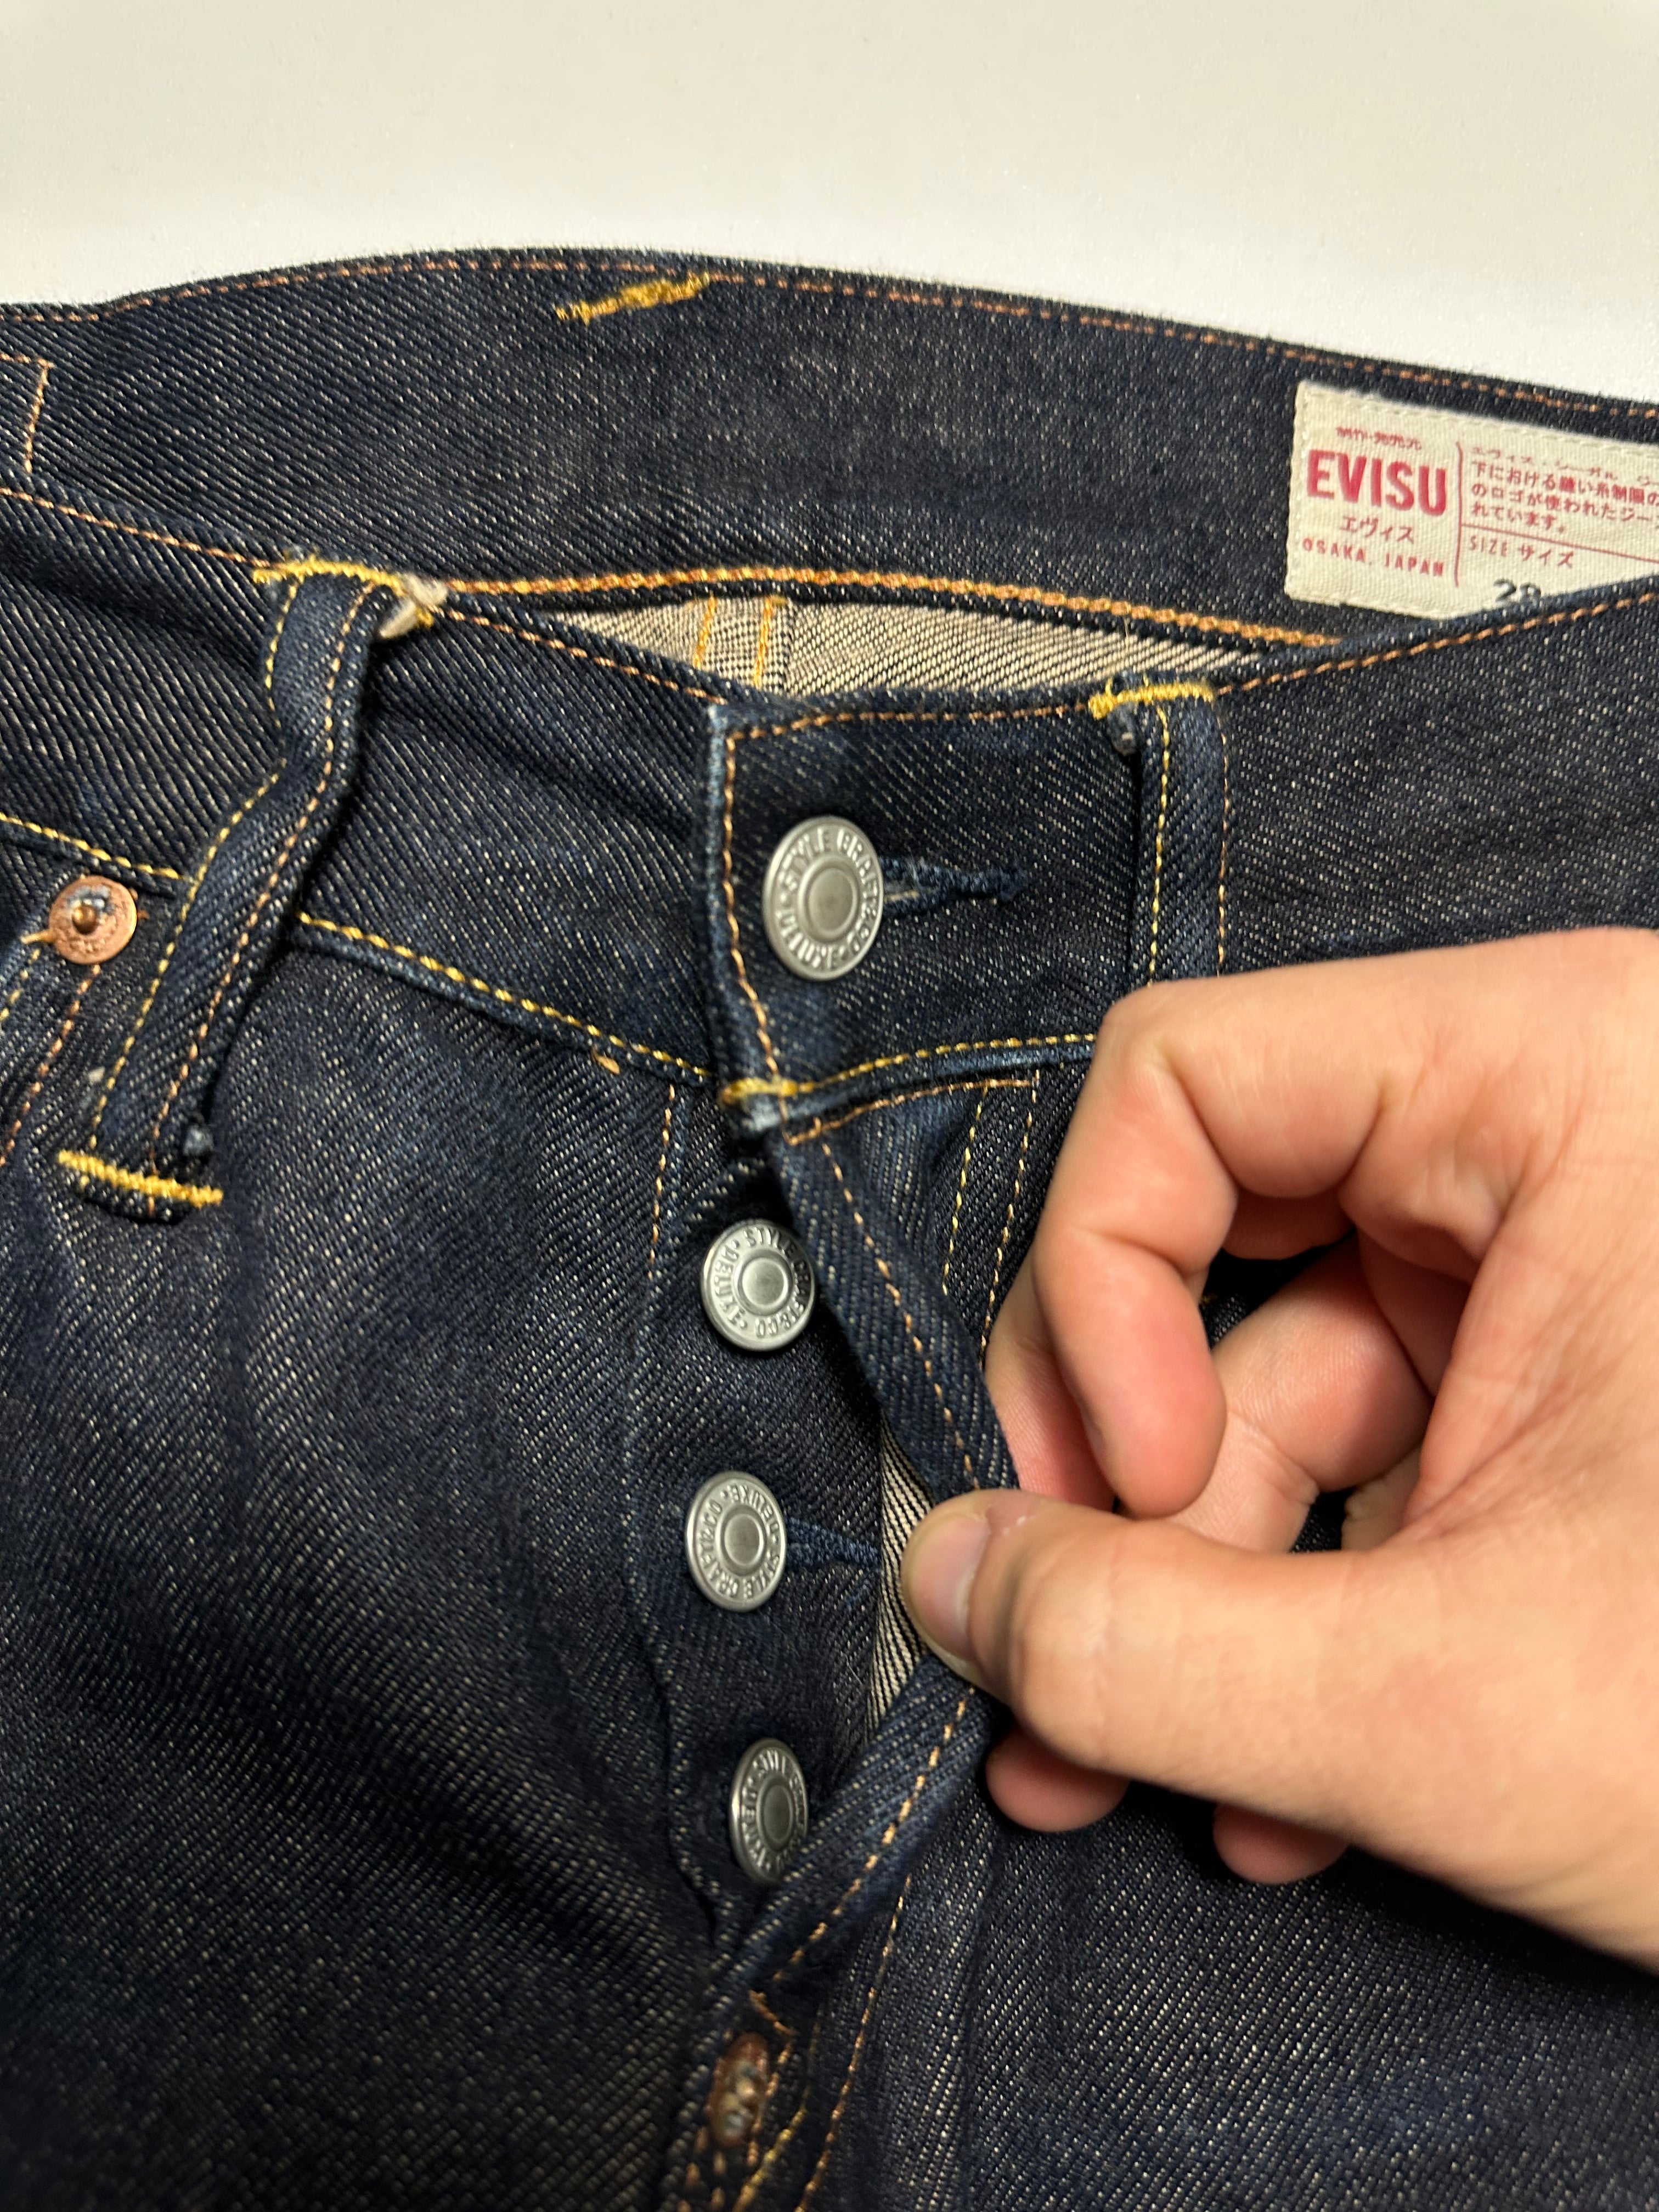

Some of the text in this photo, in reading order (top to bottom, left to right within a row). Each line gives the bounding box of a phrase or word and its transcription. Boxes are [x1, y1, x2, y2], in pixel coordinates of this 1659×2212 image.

[1307, 449, 1447, 517] EVISU
[1339, 515, 1414, 545] エヴィス
[1384, 552, 1444, 577] JAPAN
[1469, 535, 1575, 569] SIZE サイズ
